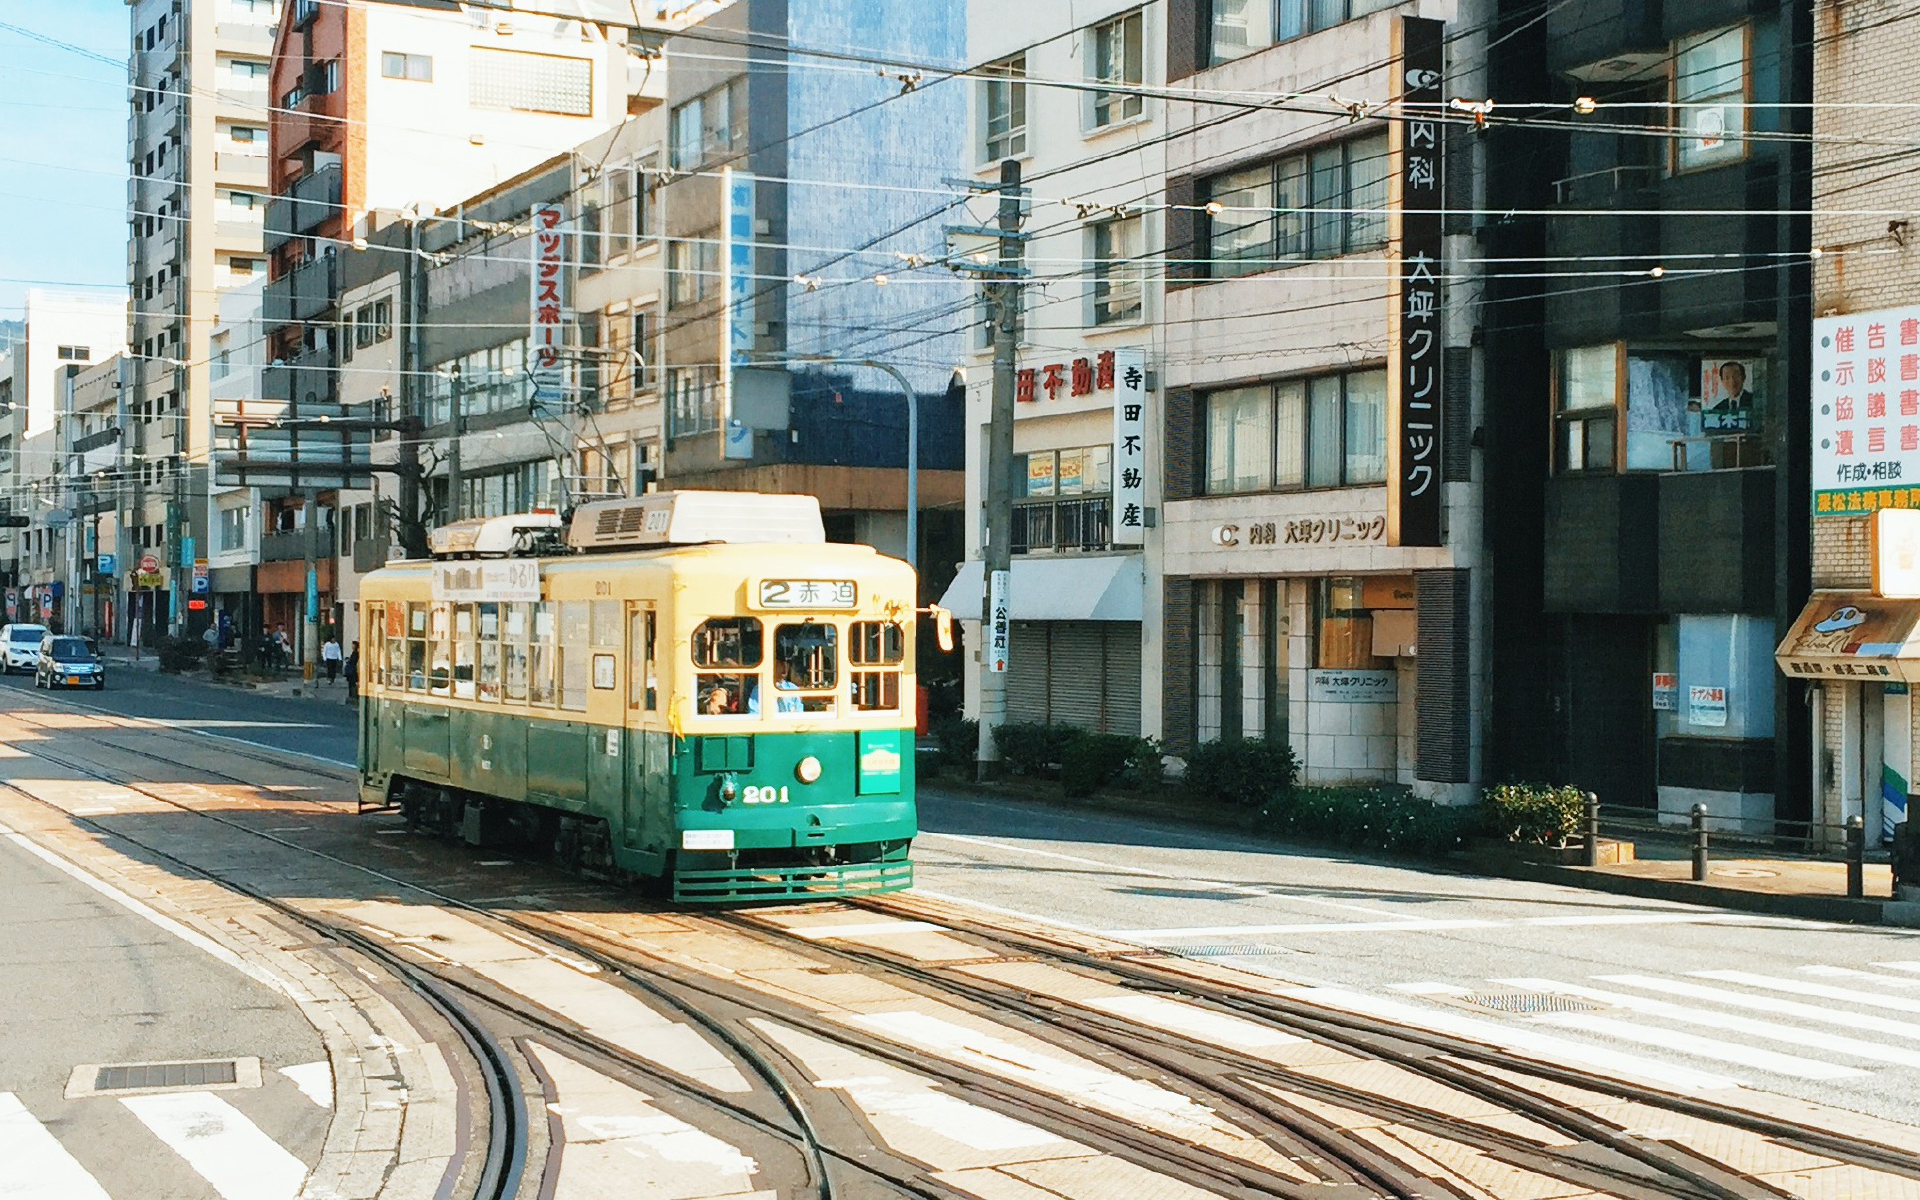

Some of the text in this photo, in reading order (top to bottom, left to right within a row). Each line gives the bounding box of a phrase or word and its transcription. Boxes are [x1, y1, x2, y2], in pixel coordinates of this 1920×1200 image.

[1408, 115, 1435, 497] 内科 大坪クリニック
[1835, 317, 1920, 353] 催告書
[1835, 354, 1920, 386] 示談書
[1835, 388, 1920, 422] 協議書
[1121, 366, 1143, 528] 寺田不動産
[1835, 424, 1920, 455] 遺言書
[1837, 461, 1902, 482] 作成・相談
[1250, 522, 1276, 545] 内科
[595, 580, 612, 595] 201
[763, 580, 791, 603] 2
[743, 785, 789, 804] 201
